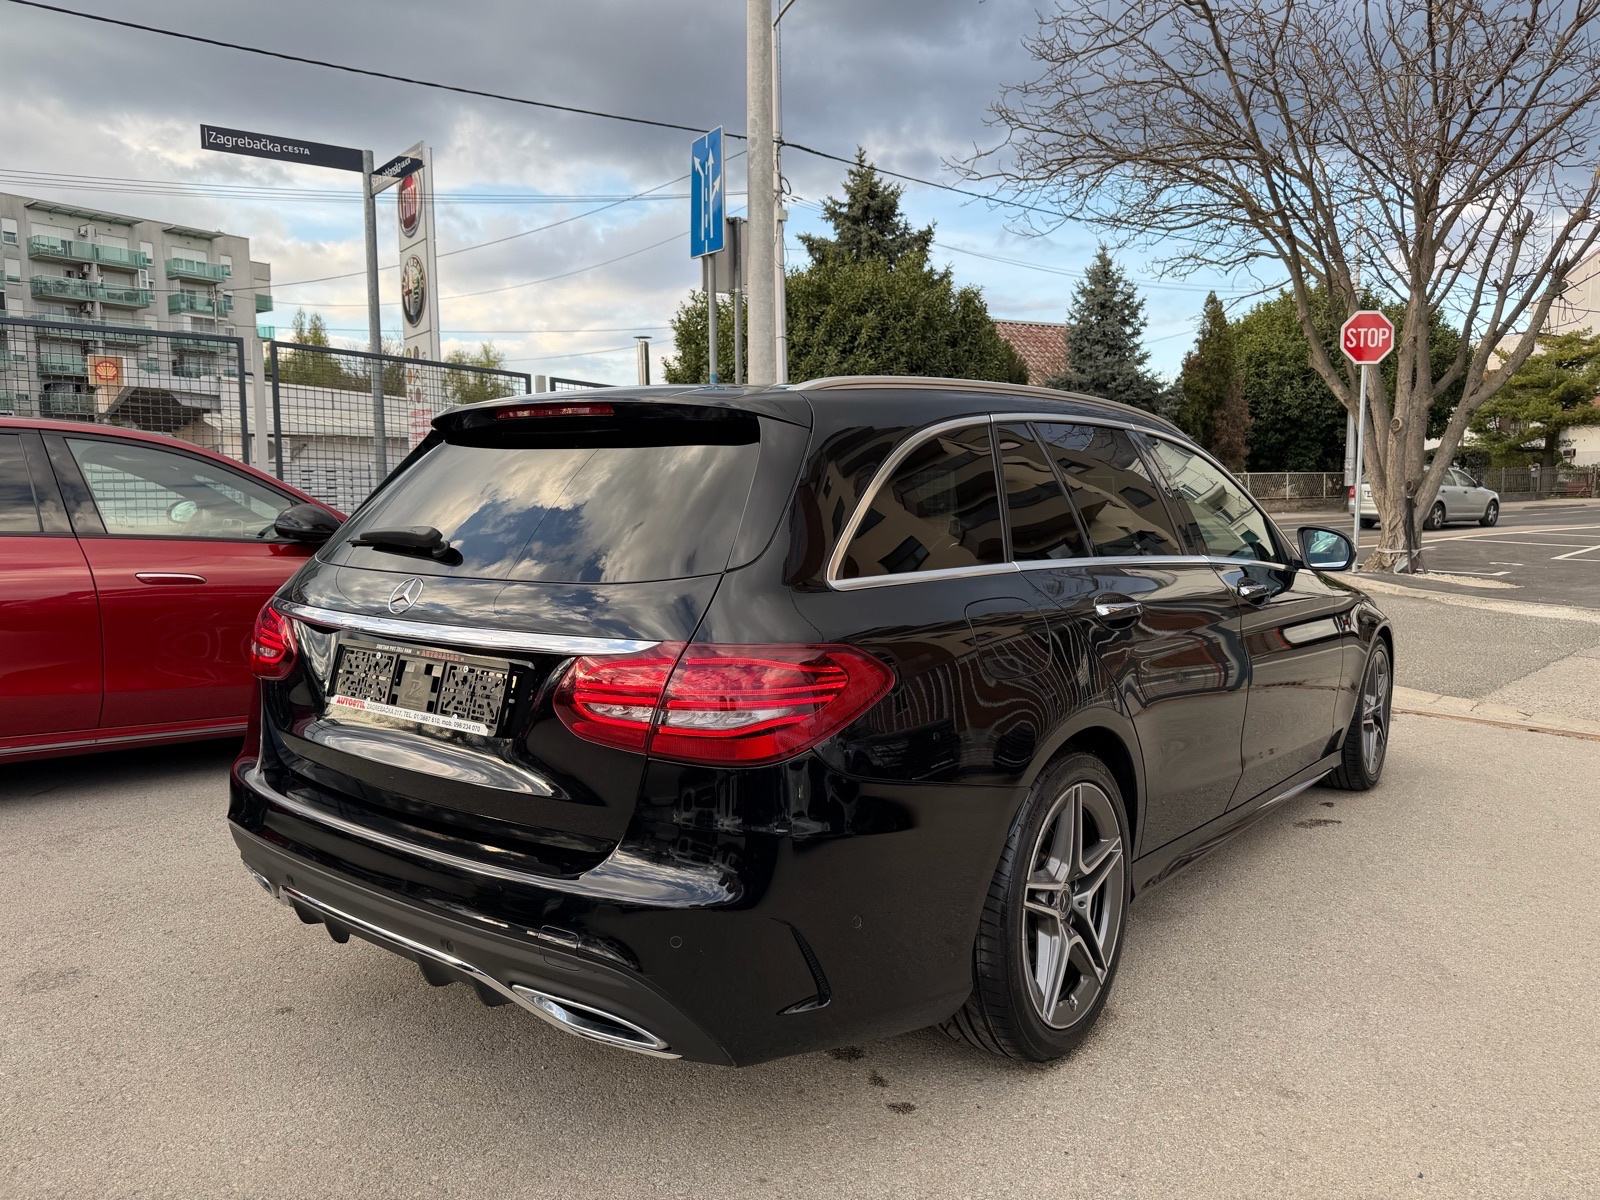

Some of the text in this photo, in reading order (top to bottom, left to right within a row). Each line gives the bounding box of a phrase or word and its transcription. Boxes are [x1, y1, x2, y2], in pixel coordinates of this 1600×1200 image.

[209, 131, 311, 155] Zagrebačka CESTA
[1346, 328, 1390, 348] STOP
